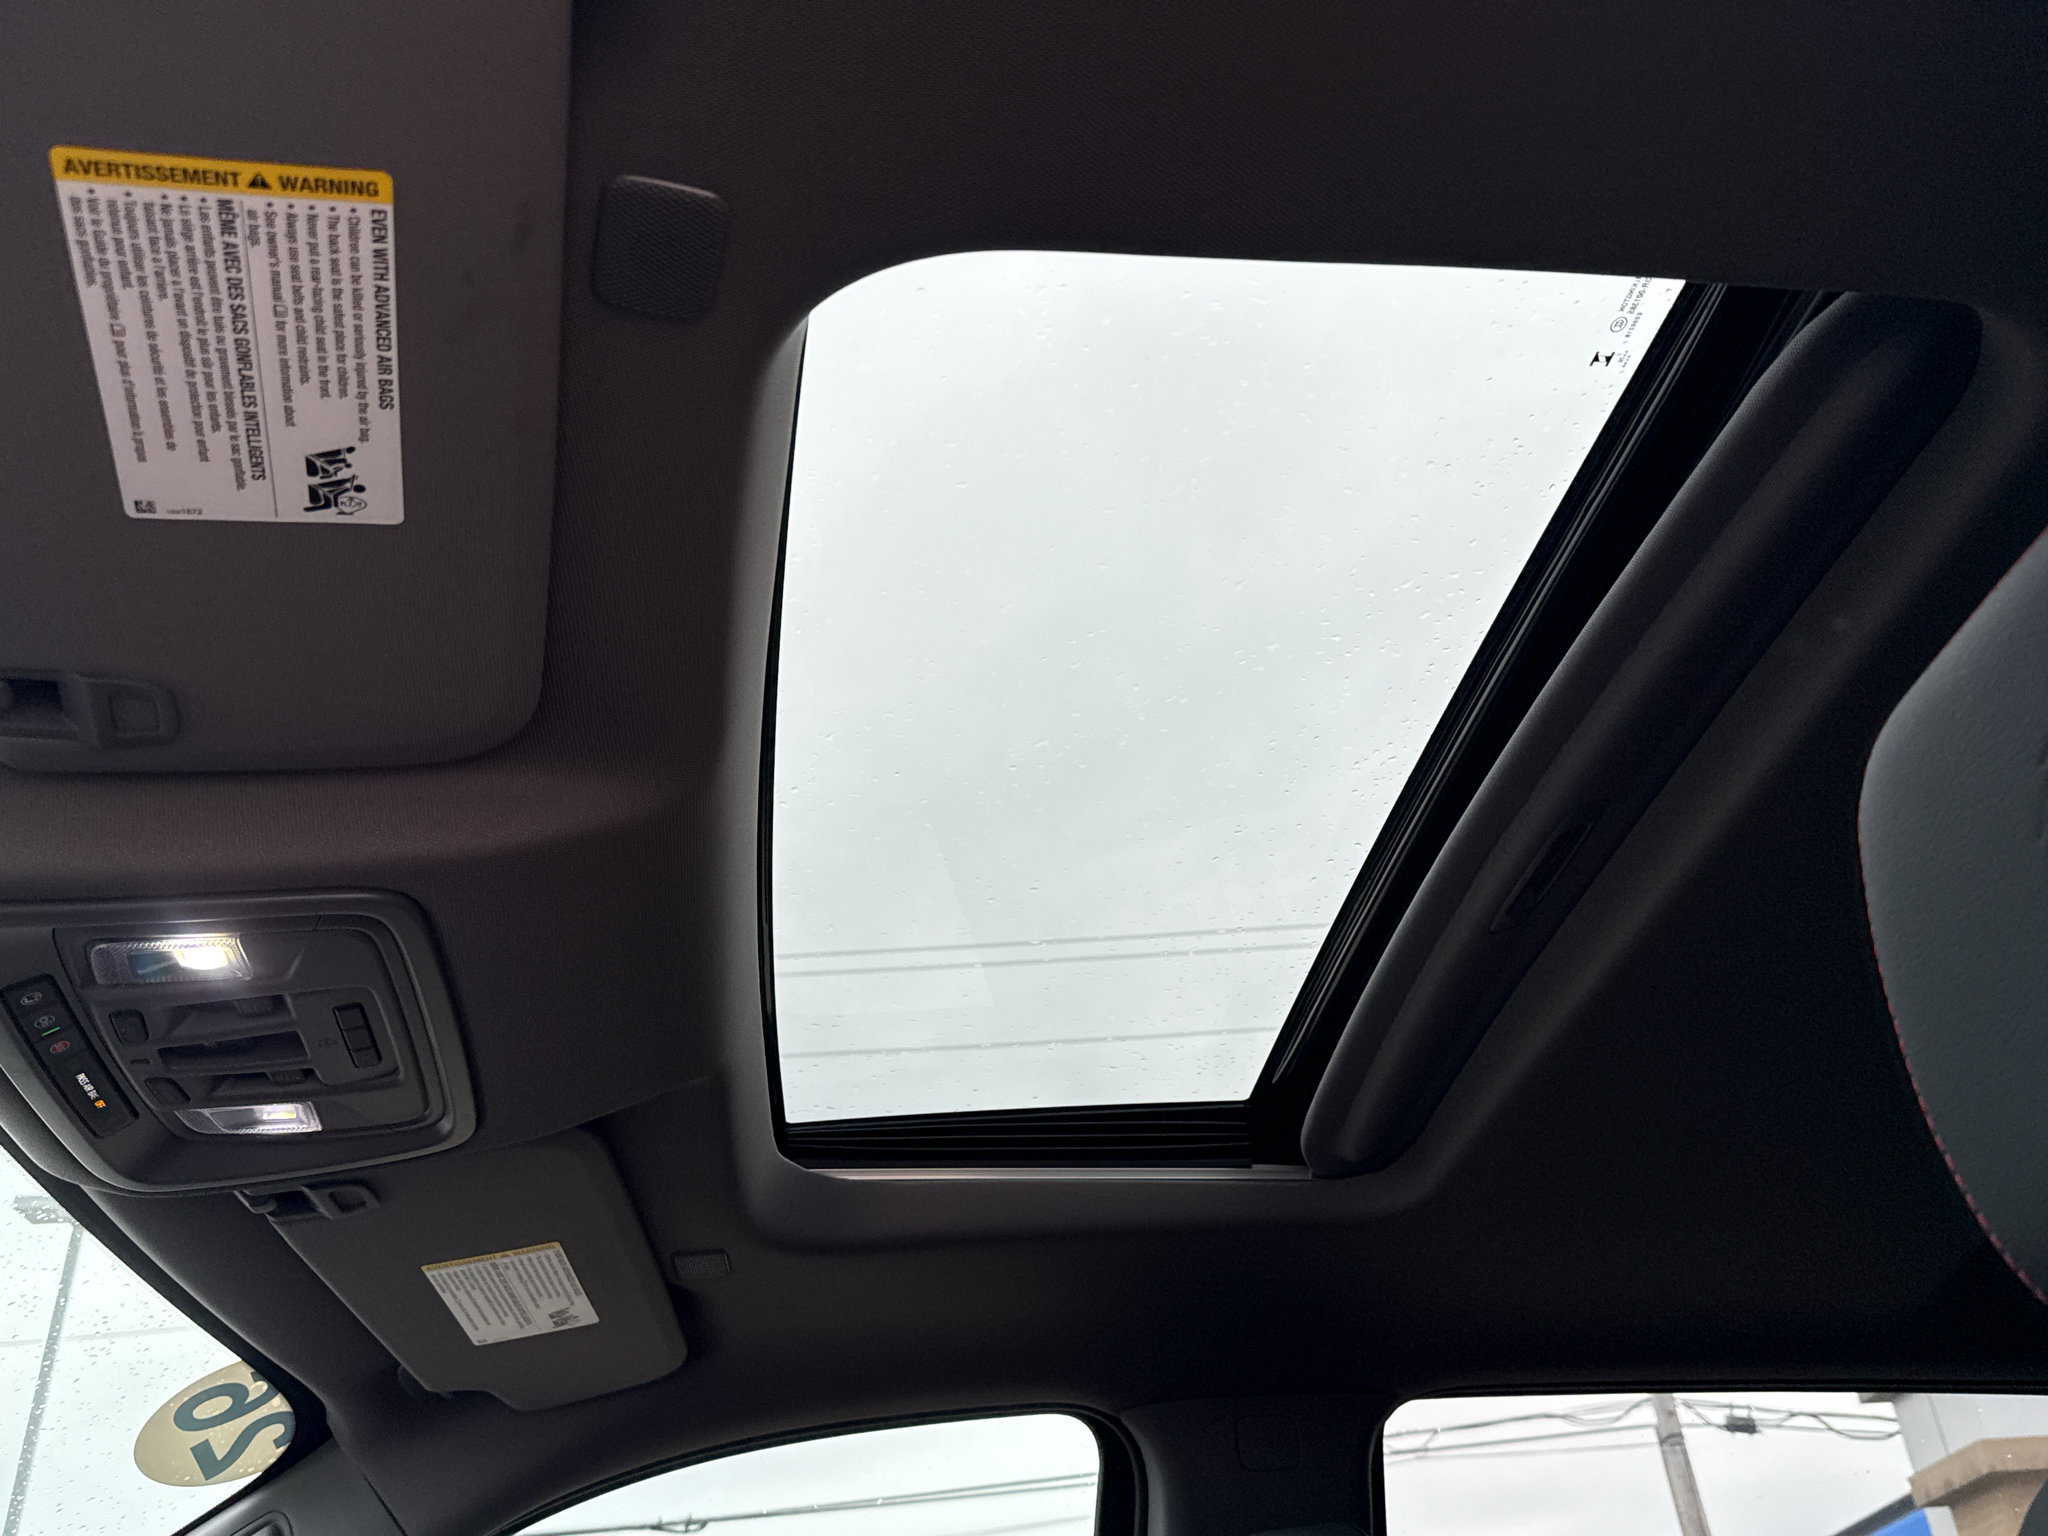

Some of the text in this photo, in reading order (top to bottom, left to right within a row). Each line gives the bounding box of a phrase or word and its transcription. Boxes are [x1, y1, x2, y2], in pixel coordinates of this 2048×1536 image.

[63, 158, 380, 198] AVERTISSEMENT WARNING
[347, 216, 361, 254] Children
[350, 256, 360, 272] can
[351, 287, 364, 311] killed
[370, 208, 393, 410] EVEN WITH ADVANCED AIR BAGS
[216, 198, 266, 480] MÊME AVEC DES SACS GONFLABLES INTELLIGENTS
[350, 323, 367, 360] seriously
[353, 362, 368, 389] injured
[358, 402, 369, 414] the
[359, 416, 370, 425] air
[356, 427, 371, 444] bag.
[75, 1072, 90, 1086] PASS
[82, 1083, 94, 1093] AIR
